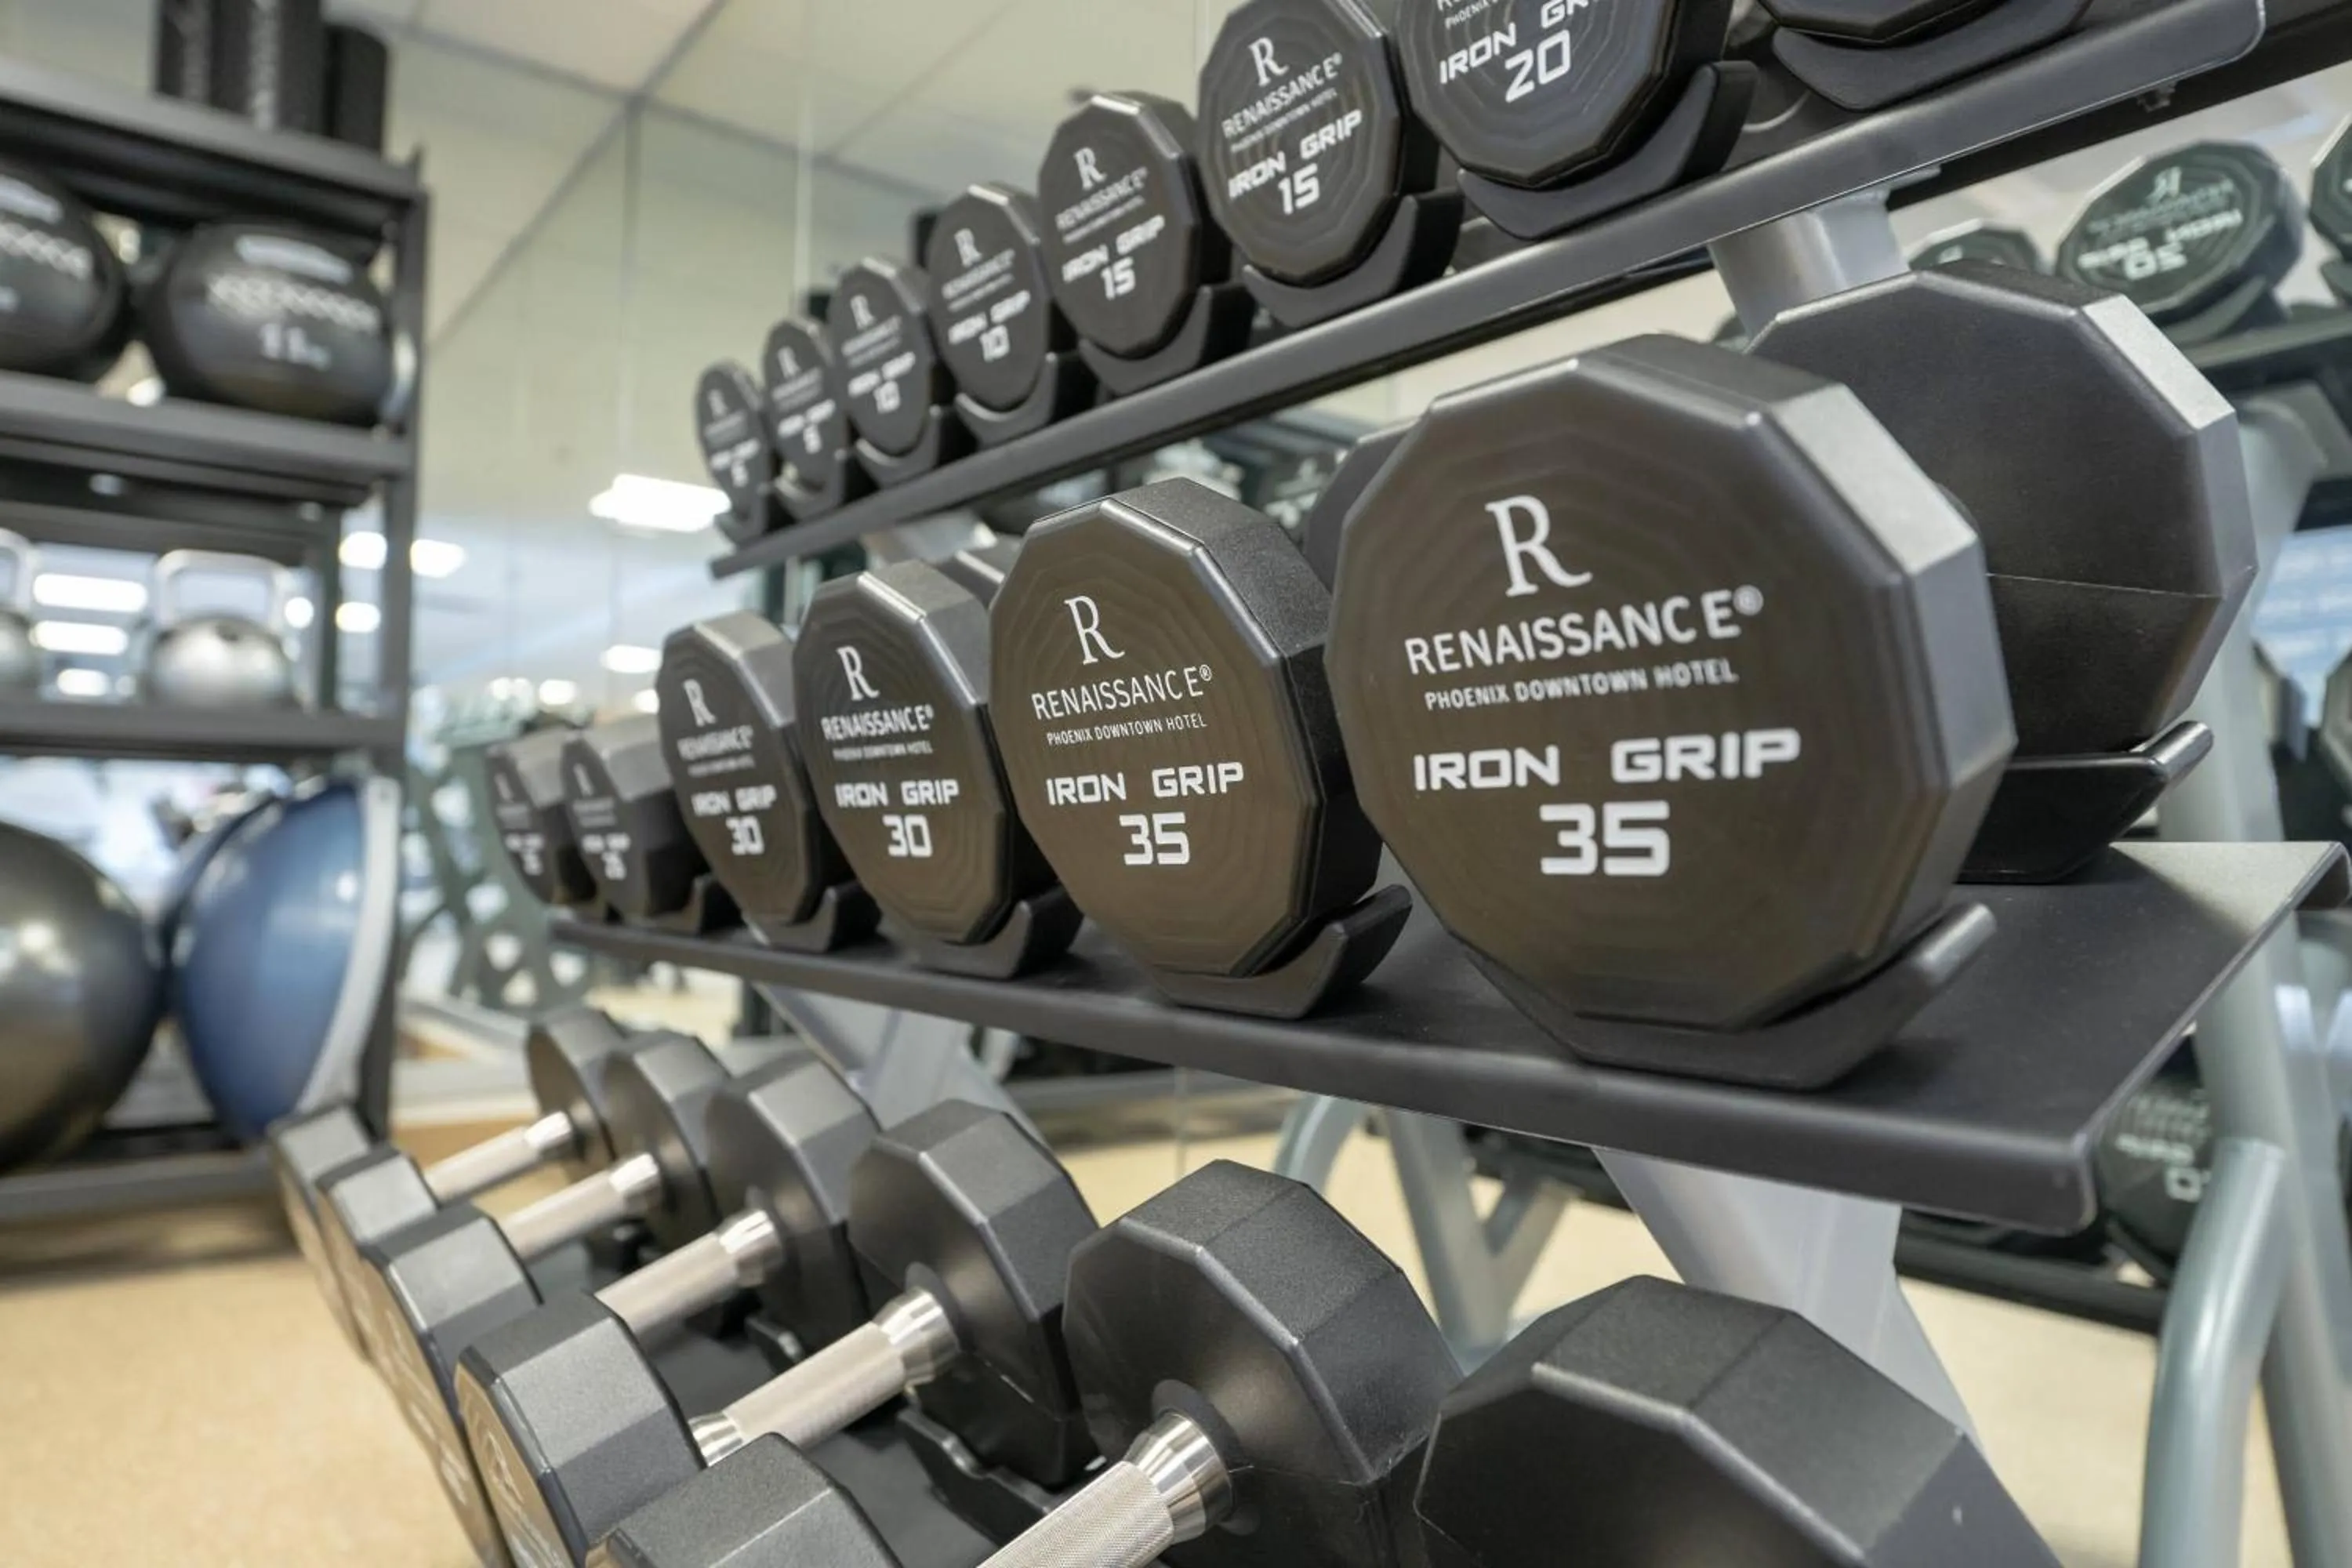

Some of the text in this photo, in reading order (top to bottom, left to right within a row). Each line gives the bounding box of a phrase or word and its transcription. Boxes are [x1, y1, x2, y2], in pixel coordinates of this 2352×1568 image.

[1248, 37, 1290, 87] R
[1439, 22, 1516, 84] IRON
[1504, 29, 1571, 103] 20
[1073, 147, 1107, 191] R
[1228, 150, 1287, 198] IRON
[1299, 108, 1363, 160] GRIP
[1278, 162, 1320, 215] 15
[1100, 256, 1136, 301] 15
[1485, 495, 1593, 597] R
[1063, 594, 1125, 666] R
[836, 645, 880, 701] R
[1030, 664, 1214, 721] RENAISSANCE®
[1424, 658, 1740, 712] PHOENIX DOWNTOWN HOTEL
[682, 678, 717, 727] R
[1047, 713, 1207, 746] PHOENIX DOWNTOWN HOTEL
[1046, 761, 1244, 806] IRON GRIP
[1414, 727, 1802, 791] IRON GRIP
[834, 778, 960, 808] IRON GRIP
[724, 815, 765, 855] 30
[882, 813, 933, 857] 30
[1119, 811, 1191, 866] 35
[1539, 800, 1671, 877] 35
